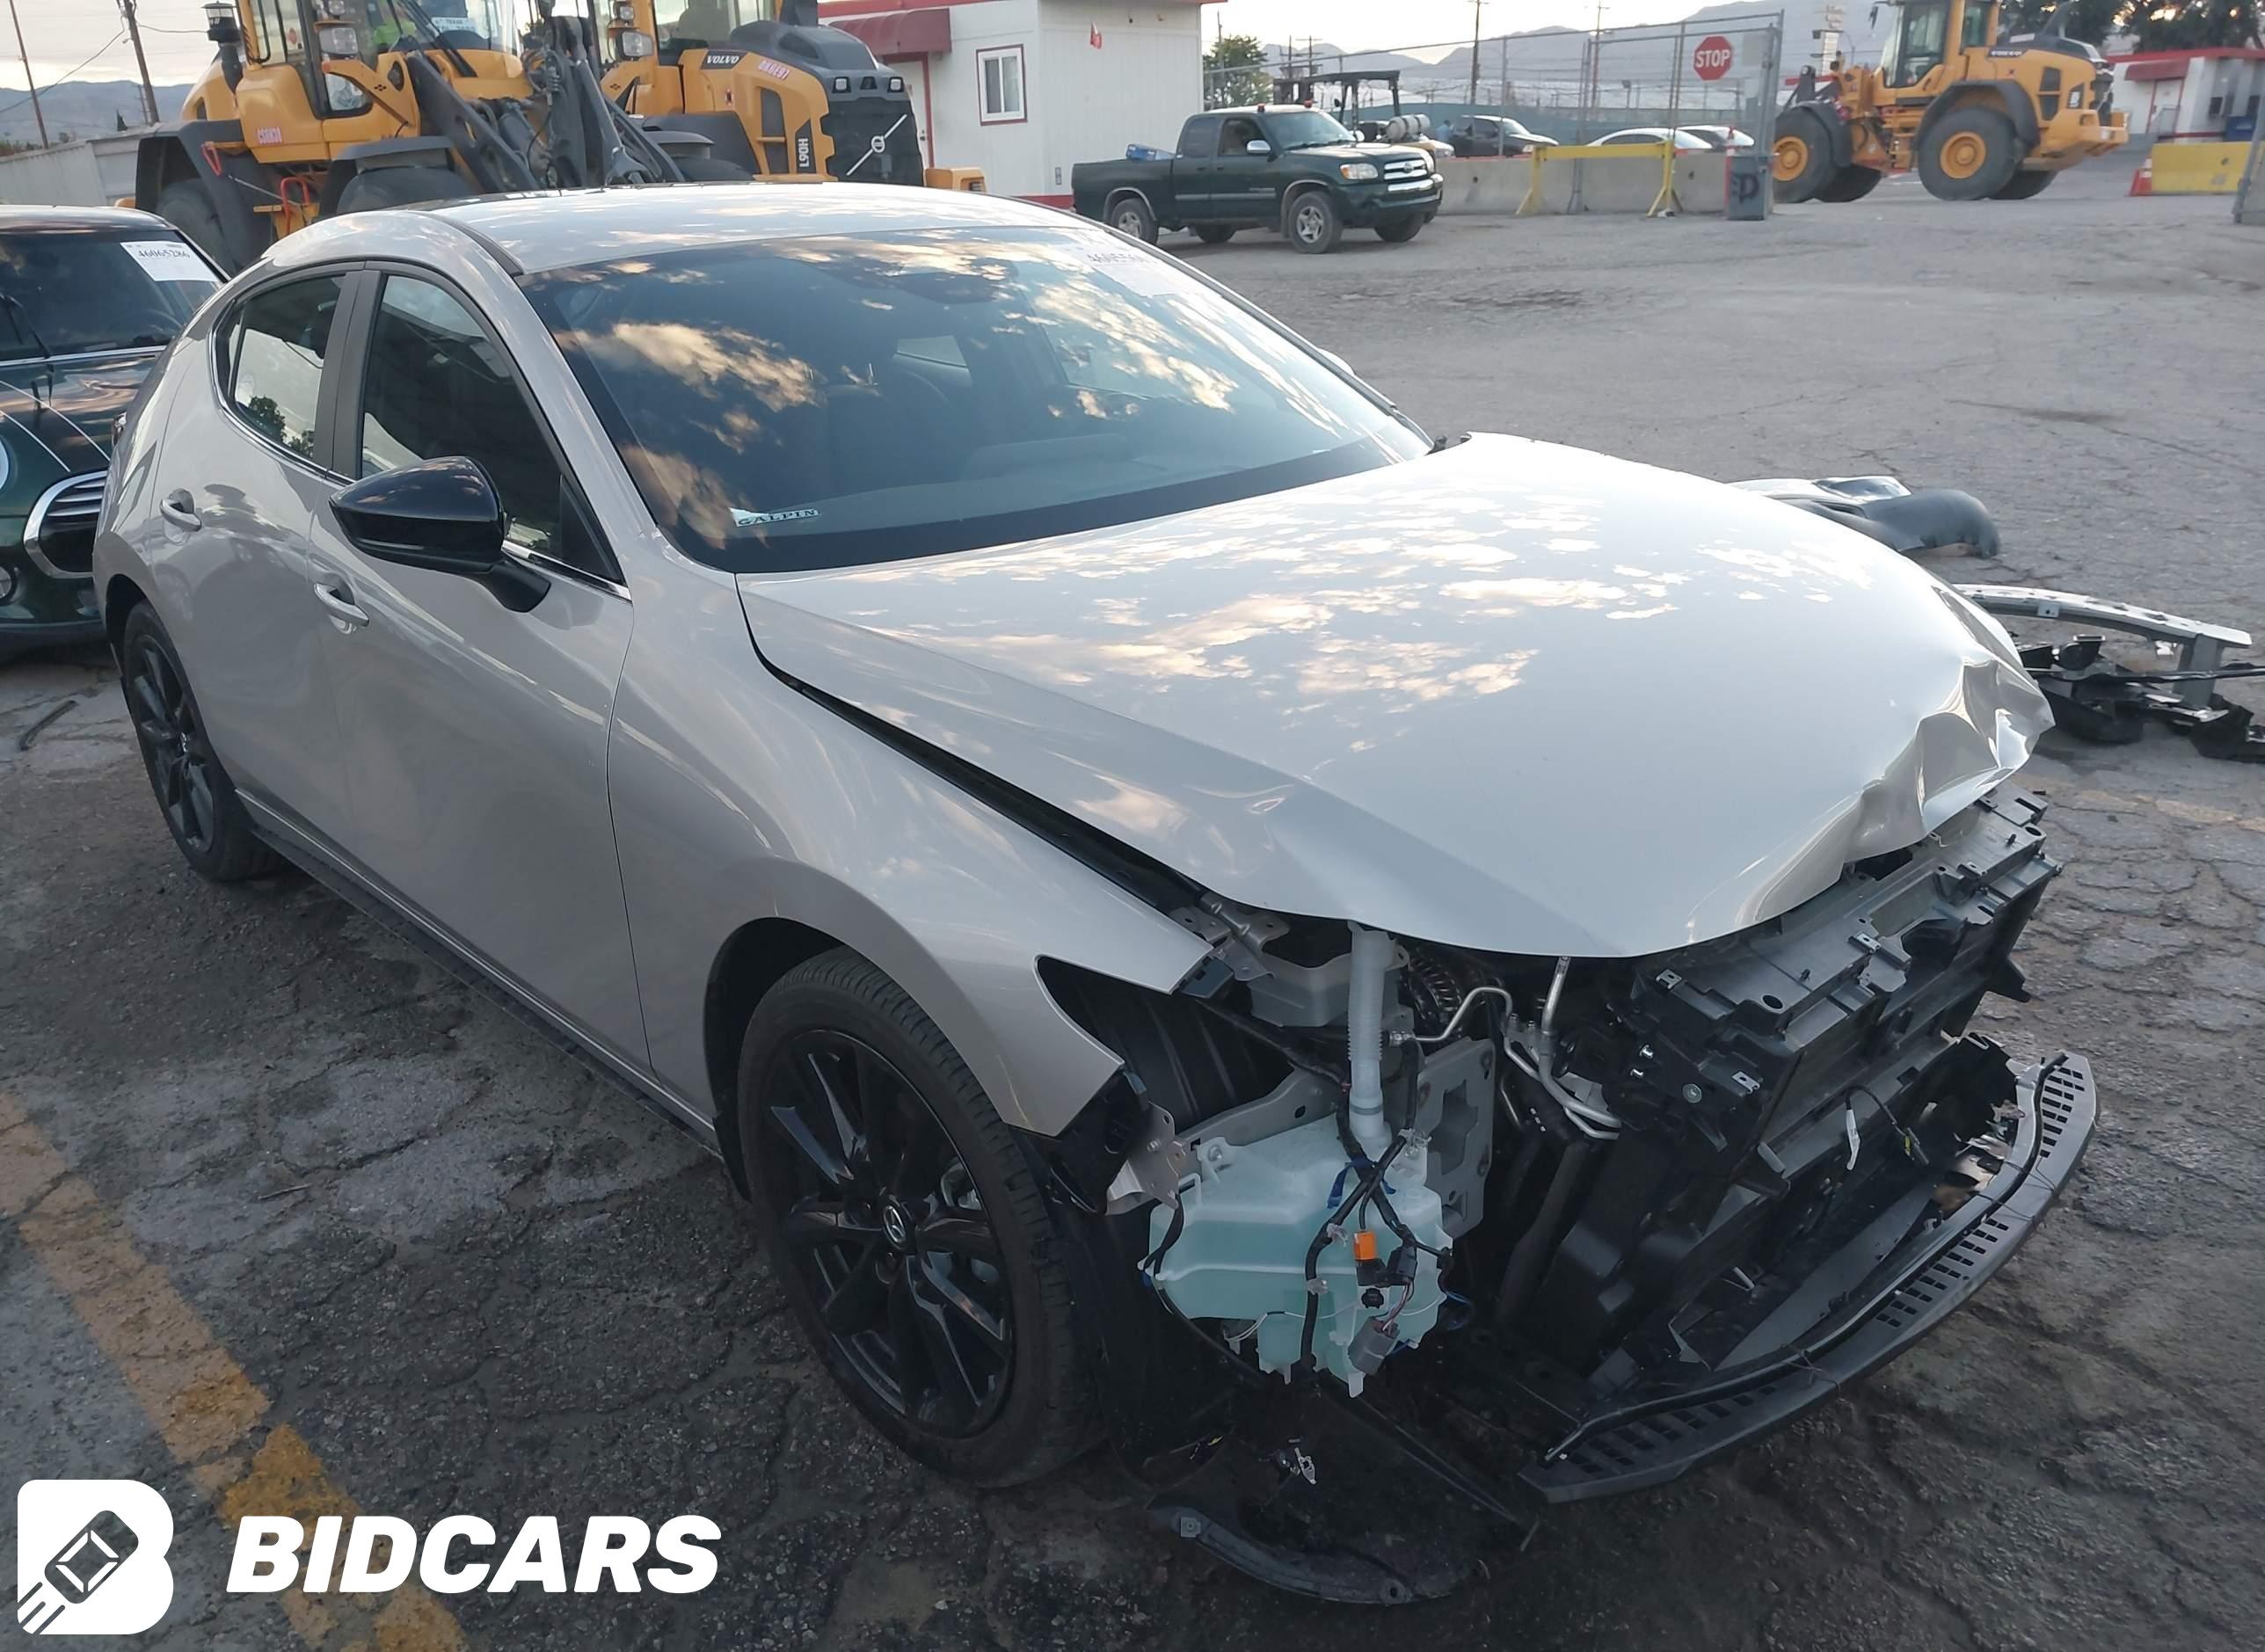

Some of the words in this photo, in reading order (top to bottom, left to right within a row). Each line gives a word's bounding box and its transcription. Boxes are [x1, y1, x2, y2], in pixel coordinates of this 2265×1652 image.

[706, 55, 739, 64] VOLVO
[1694, 48, 1731, 68] STOP
[797, 138, 810, 167] L90H
[738, 510, 815, 525] GALPIN
